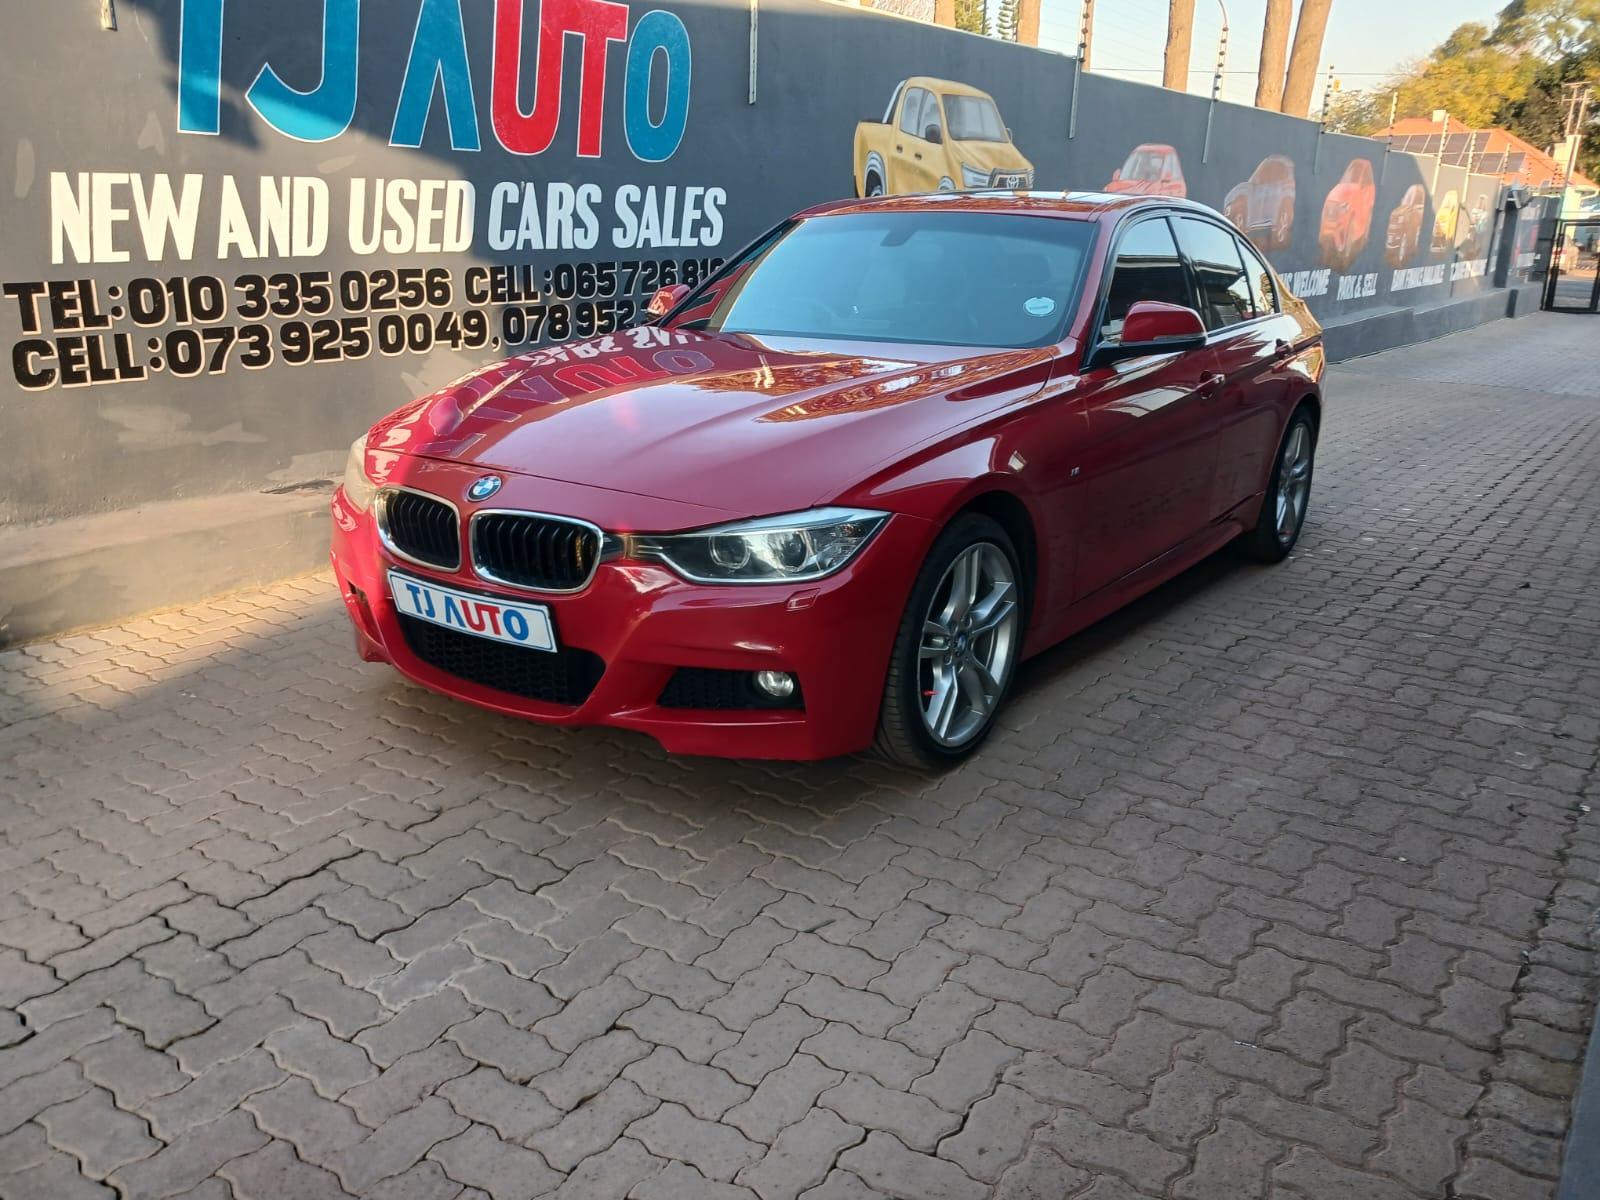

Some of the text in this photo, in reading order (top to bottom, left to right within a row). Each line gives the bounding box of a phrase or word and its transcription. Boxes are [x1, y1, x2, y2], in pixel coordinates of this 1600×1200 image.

[388, 0, 692, 162] AUTO
[50, 172, 727, 264] NEW AND USED CARS SALES
[234, 271, 332, 321] 335
[340, 267, 452, 313] 0256
[620, 260, 679, 298] 726
[1293, 268, 1331, 298] WELCOME
[1362, 272, 1378, 297] SELL
[279, 319, 374, 366] 925
[575, 300, 637, 338] 952
[407, 585, 529, 640] TJ AUTO
